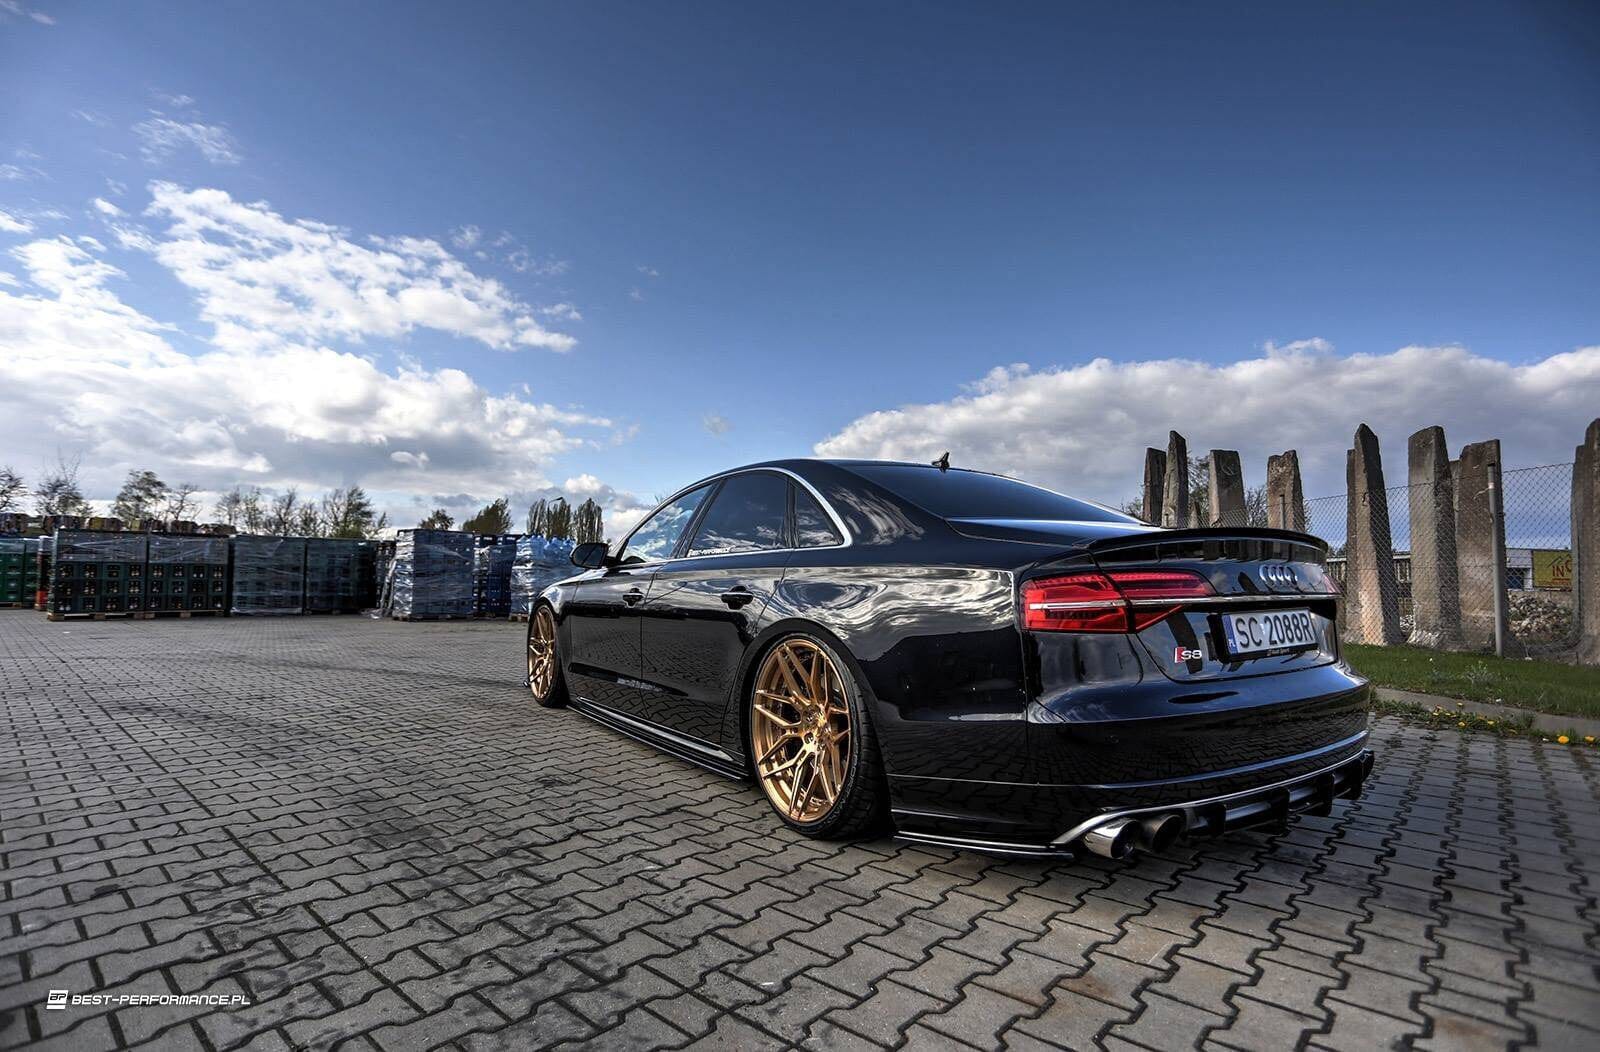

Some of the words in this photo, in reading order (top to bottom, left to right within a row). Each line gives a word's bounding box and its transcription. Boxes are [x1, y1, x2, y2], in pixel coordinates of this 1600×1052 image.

[1235, 617, 1262, 648] SC
[1264, 613, 1313, 645] 2088R
[1180, 649, 1203, 660] S8
